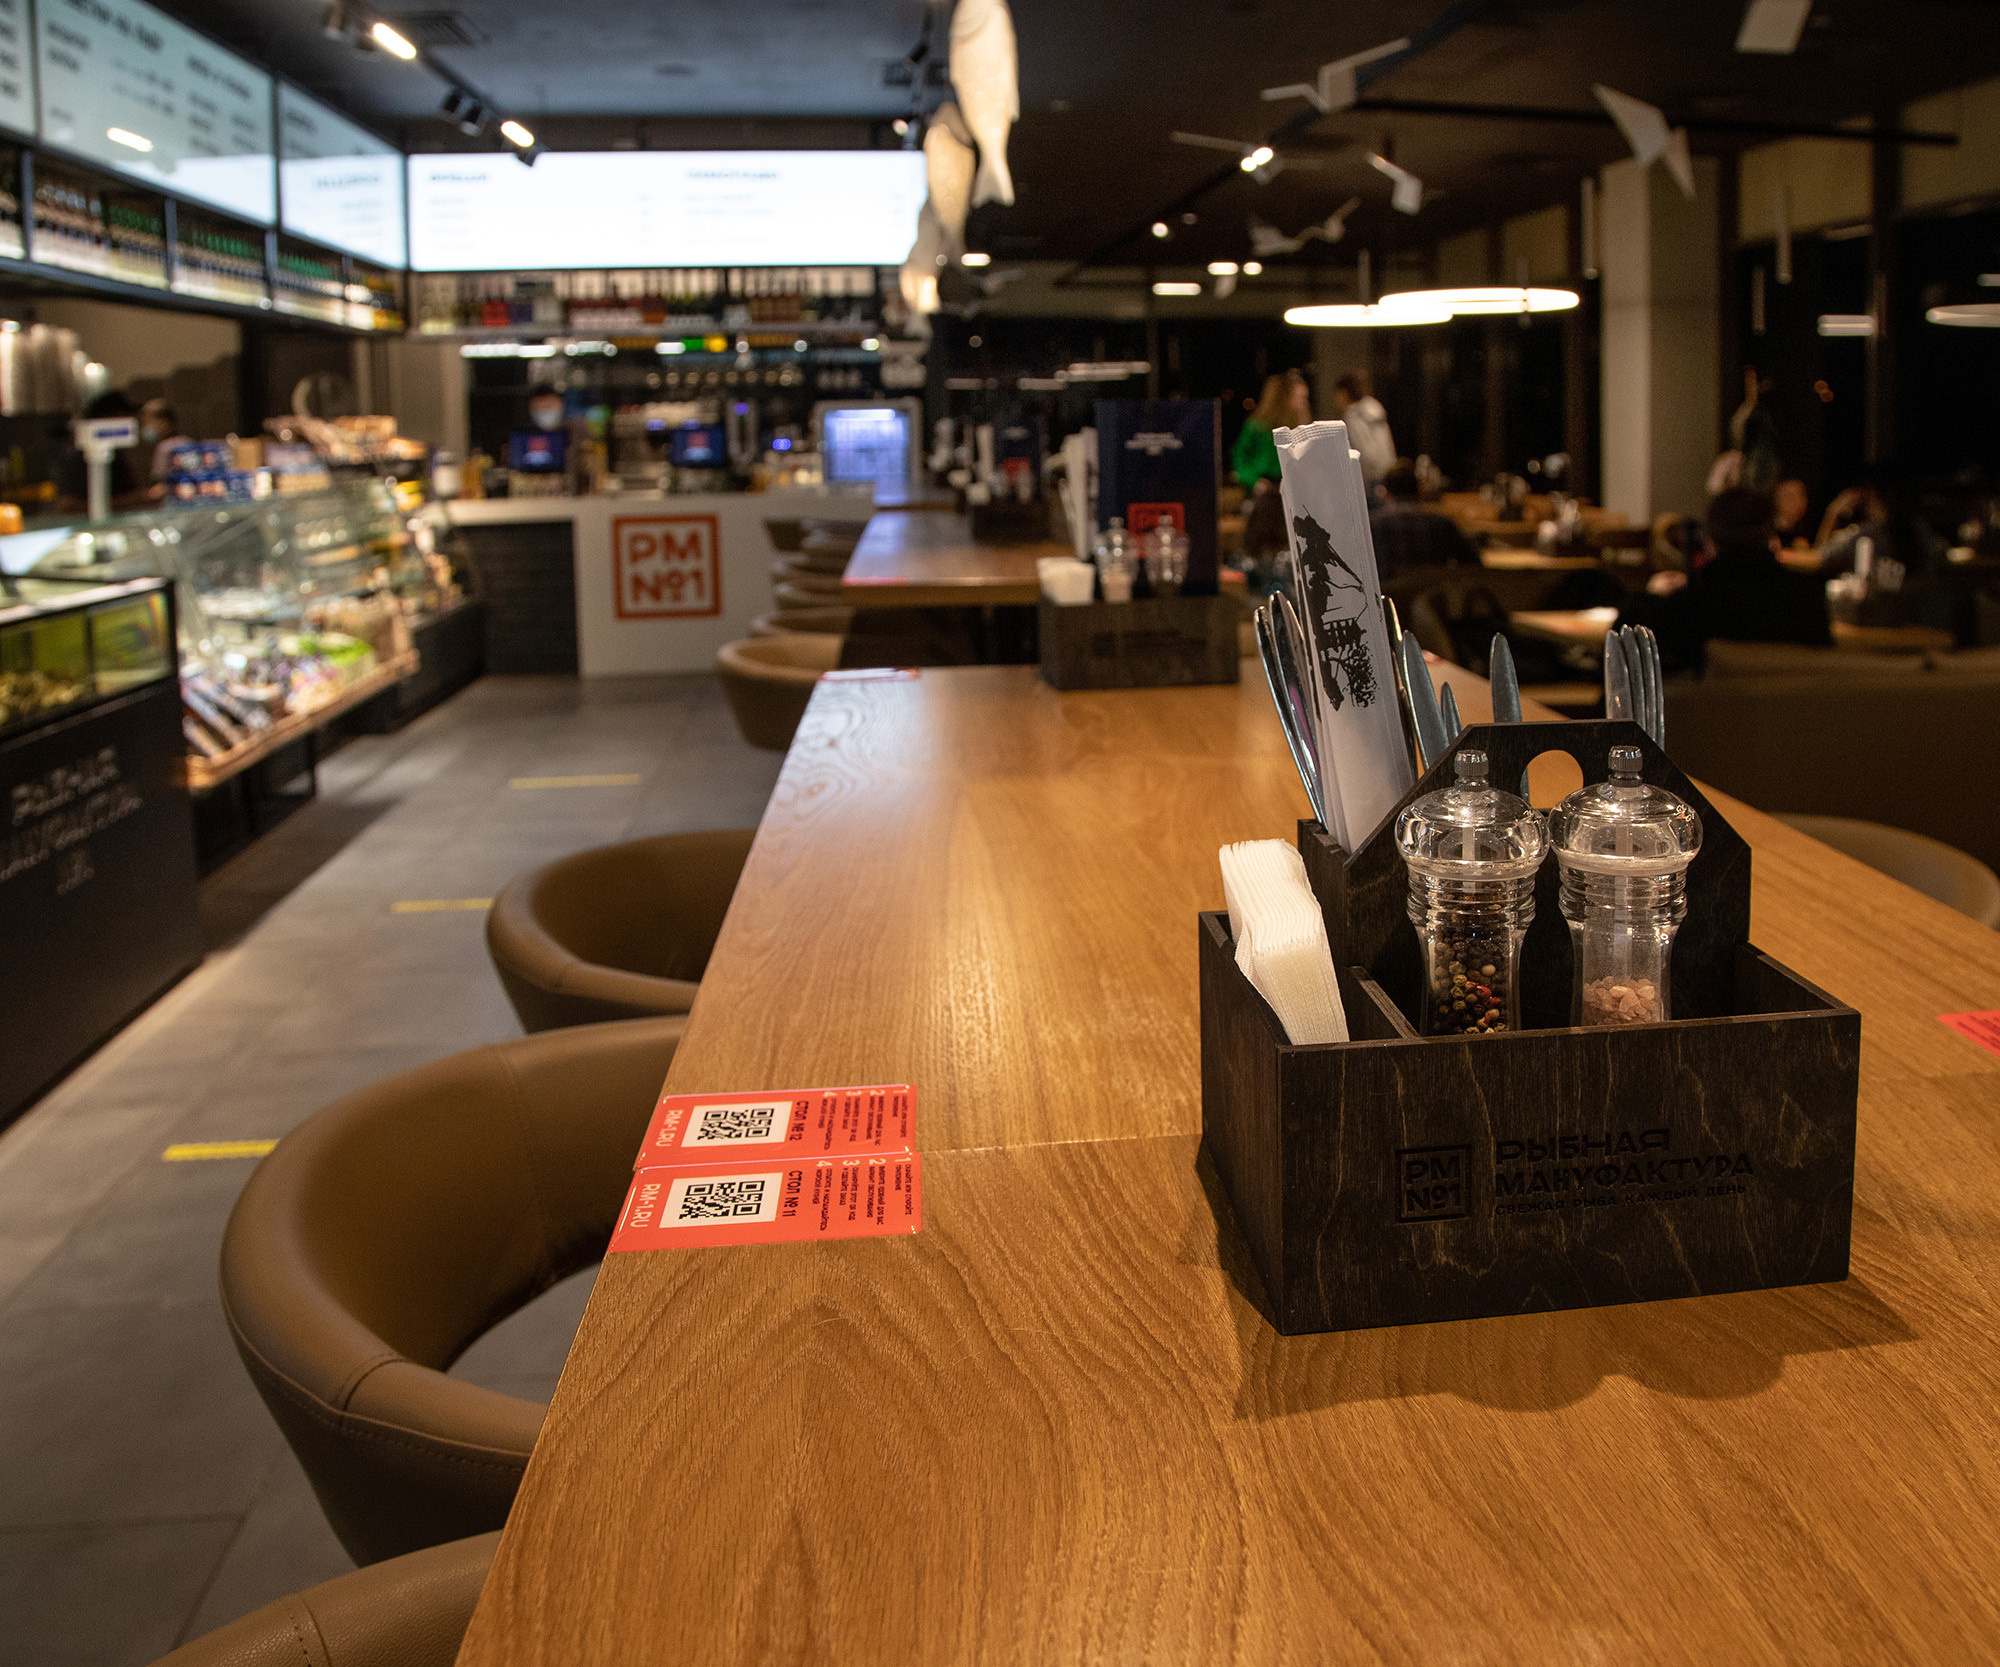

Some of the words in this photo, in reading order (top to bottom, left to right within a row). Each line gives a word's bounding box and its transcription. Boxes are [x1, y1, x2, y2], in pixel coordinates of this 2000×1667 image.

[795, 1100, 809, 1120] СТОЛ
[790, 1133, 802, 1141] 12
[1496, 1128, 1670, 1165] РЫБНАЯ
[787, 1170, 803, 1194] СТОЛ
[1406, 1155, 1460, 1185] РМ
[1495, 1152, 1754, 1198] МАНУФАКТУРА
[630, 1183, 661, 1228] RM-1.RU
[784, 1197, 799, 1208] №
[1495, 1199, 1565, 1215] СВЕЖАЯ
[1574, 1195, 1616, 1208] РЫБА
[1626, 1184, 1698, 1204] КАЖДЫЙ
[1705, 1183, 1746, 1198] ДЕНЬ
[782, 1209, 796, 1217] 11
